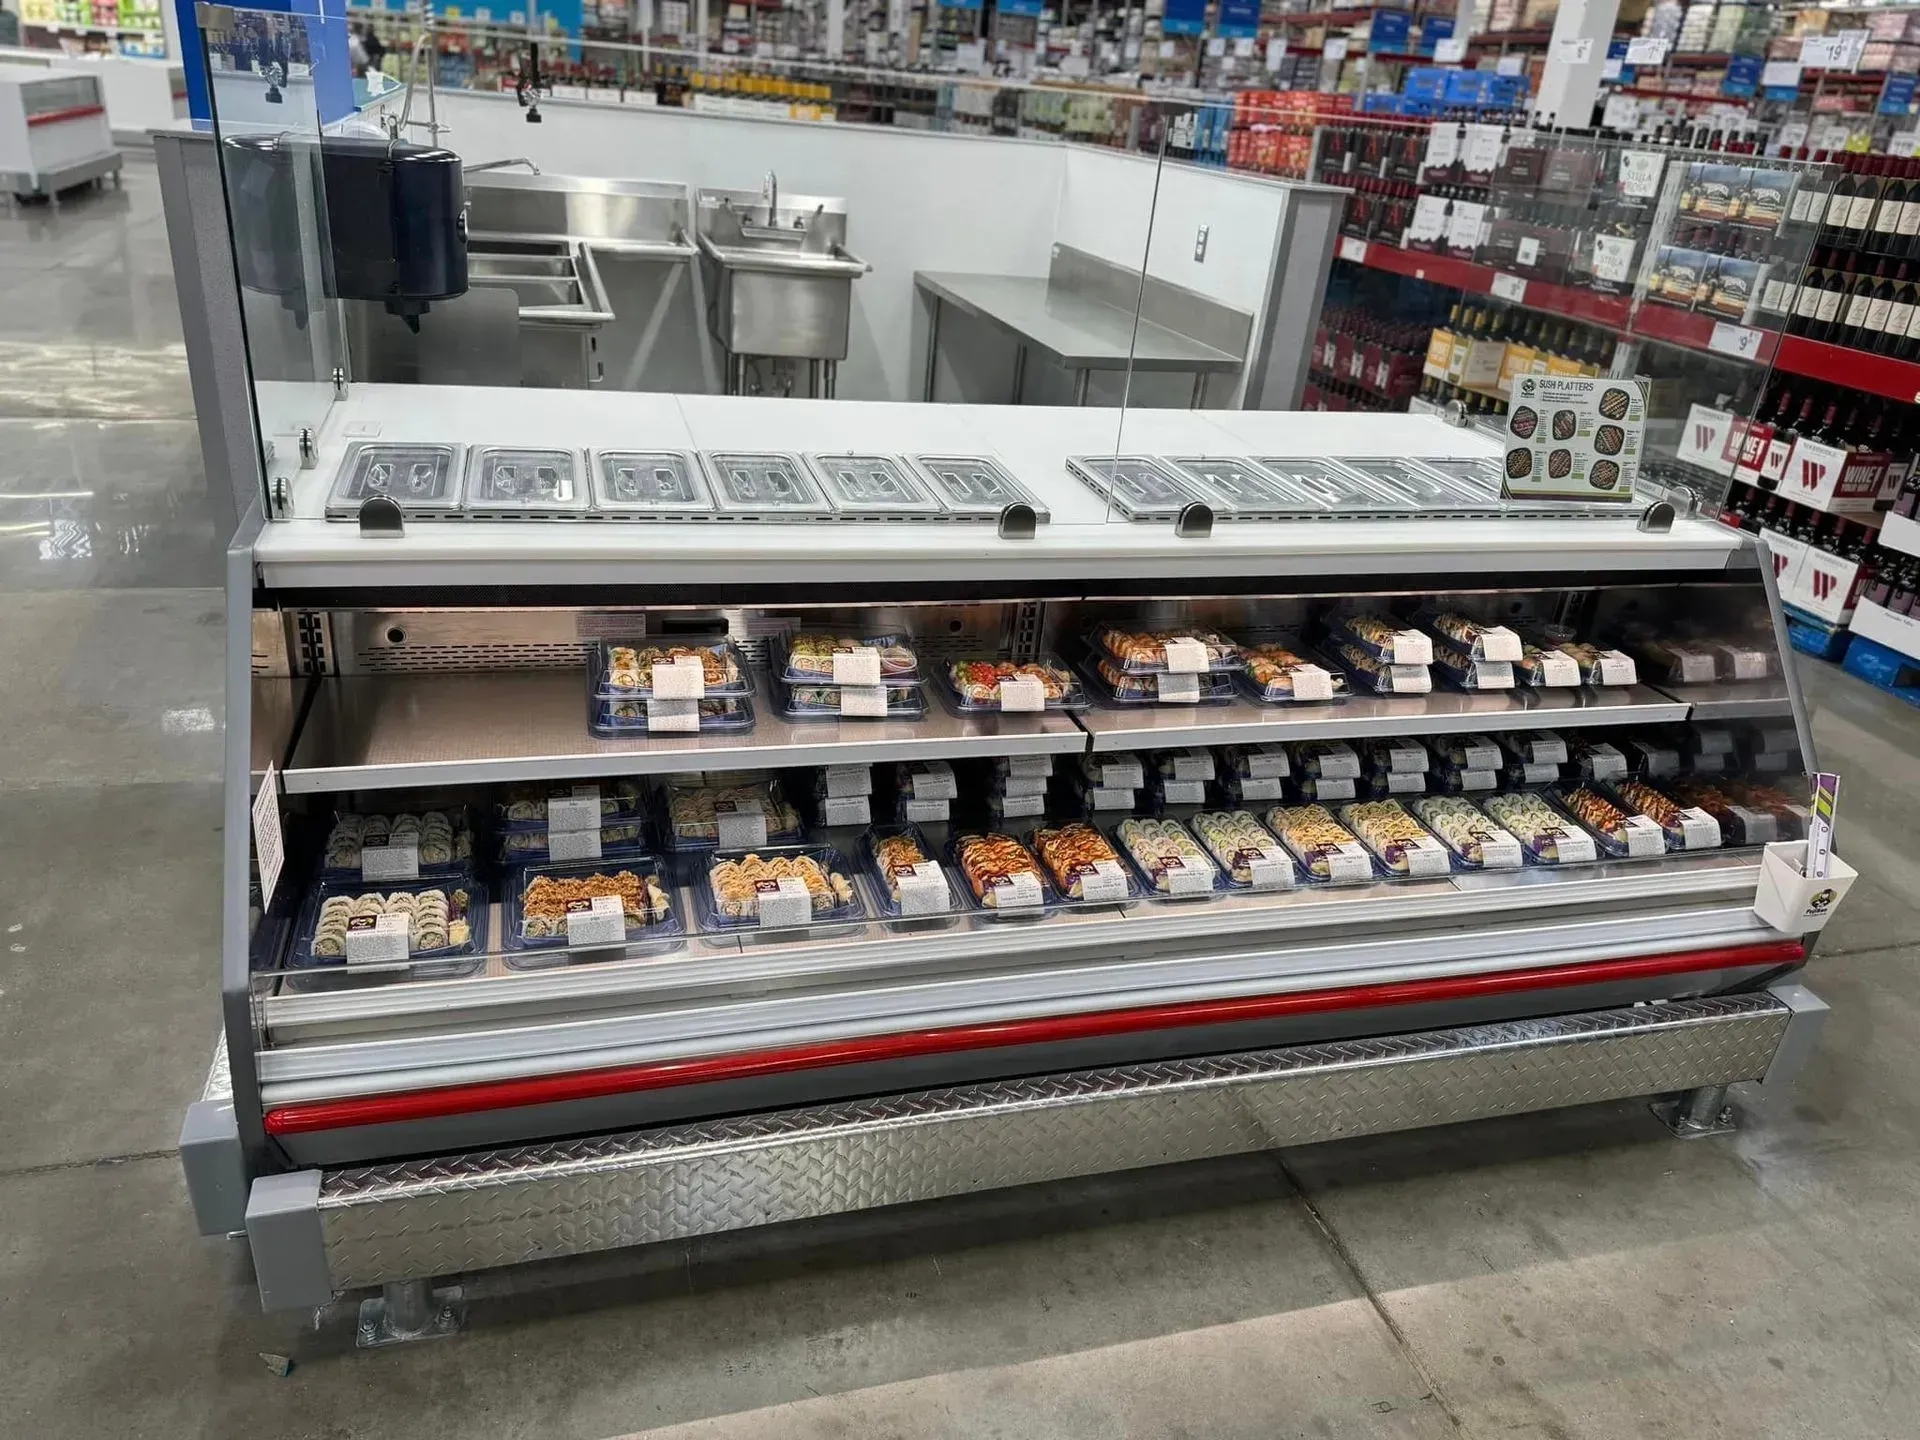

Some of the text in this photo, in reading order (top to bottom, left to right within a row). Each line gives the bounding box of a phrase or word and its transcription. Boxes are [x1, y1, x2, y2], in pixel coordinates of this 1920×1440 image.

[1539, 379, 1594, 392] SUSHI PLATTERS
[1802, 459, 1827, 491] W
[1812, 569, 1838, 601] W
